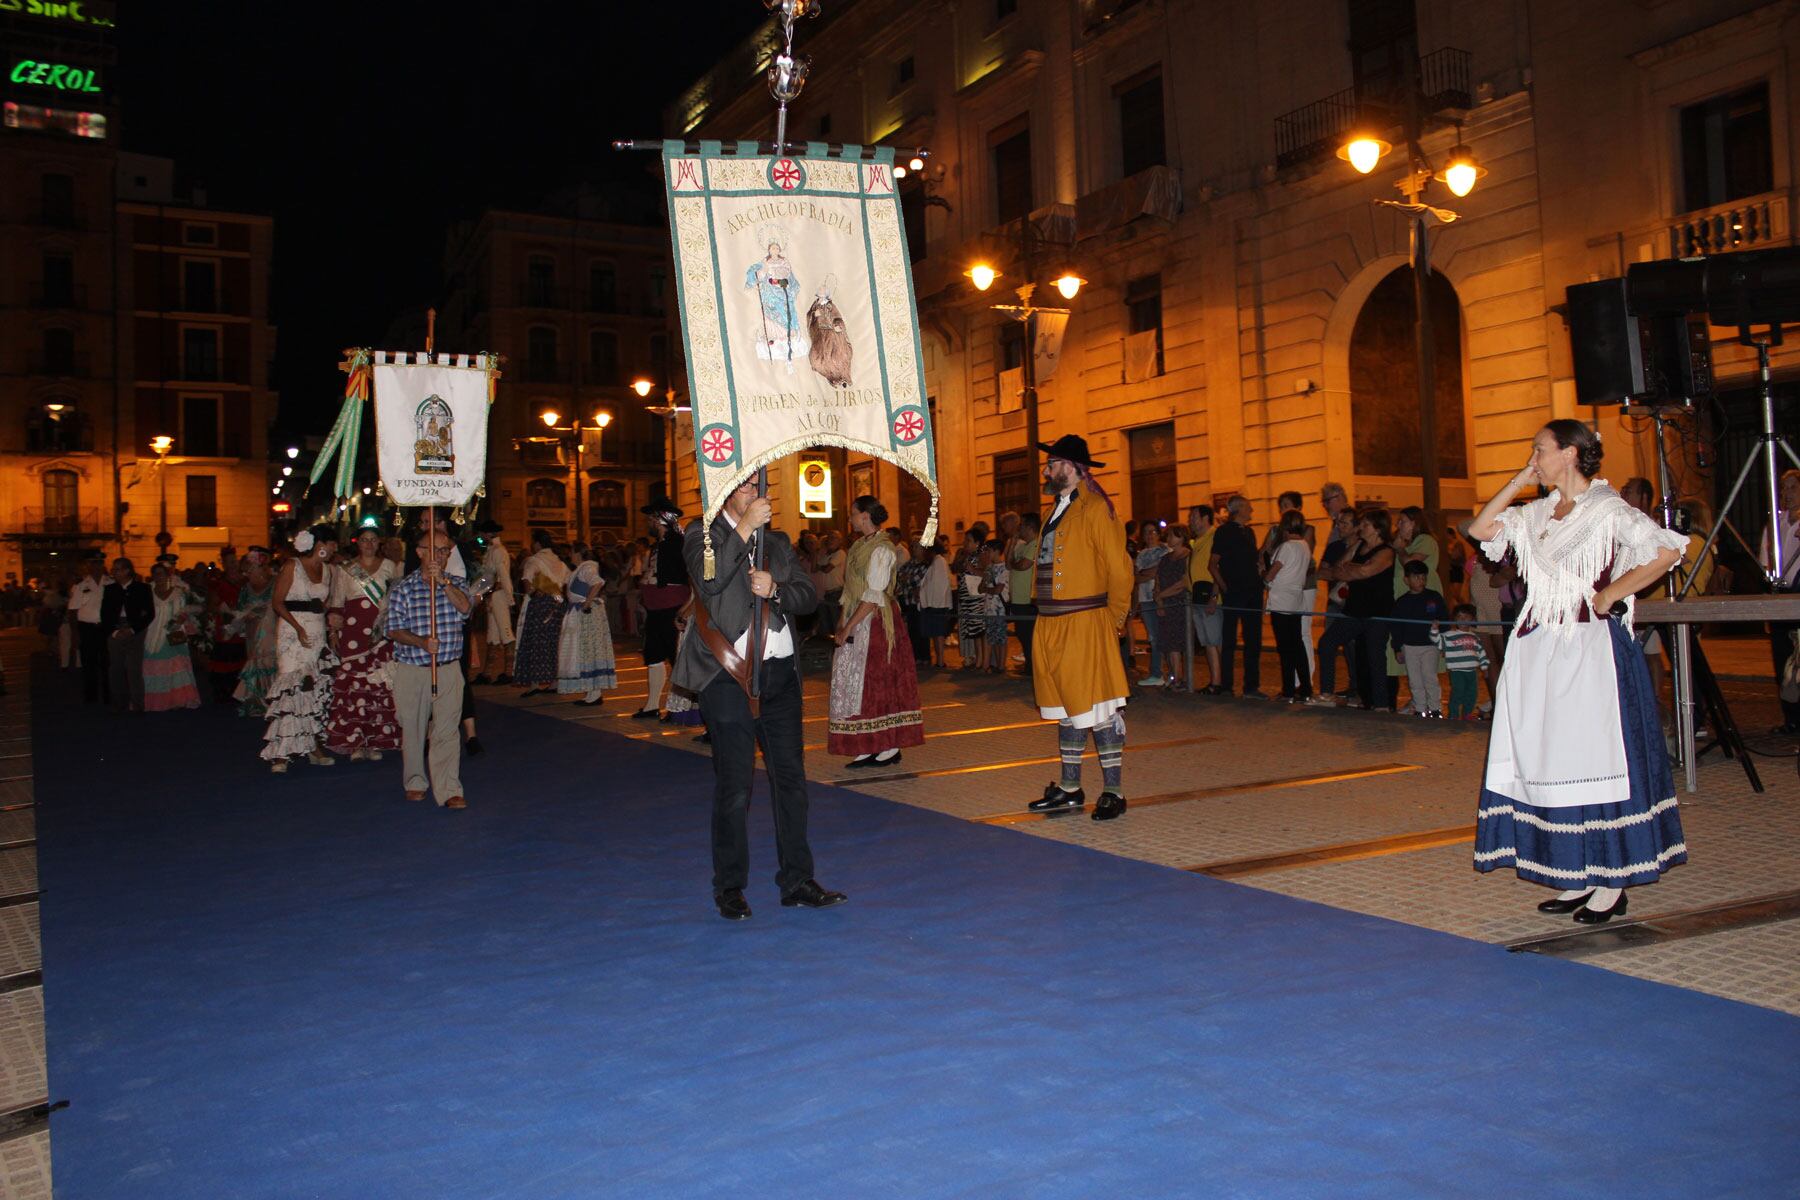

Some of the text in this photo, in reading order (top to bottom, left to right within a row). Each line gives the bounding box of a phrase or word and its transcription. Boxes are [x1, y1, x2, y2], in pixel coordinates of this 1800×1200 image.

[10, 60, 103, 92] CEROL
[740, 391, 801, 413] VIRGEN
[397, 479, 450, 488] FUNDADA
[420, 488, 439, 496] 1974
